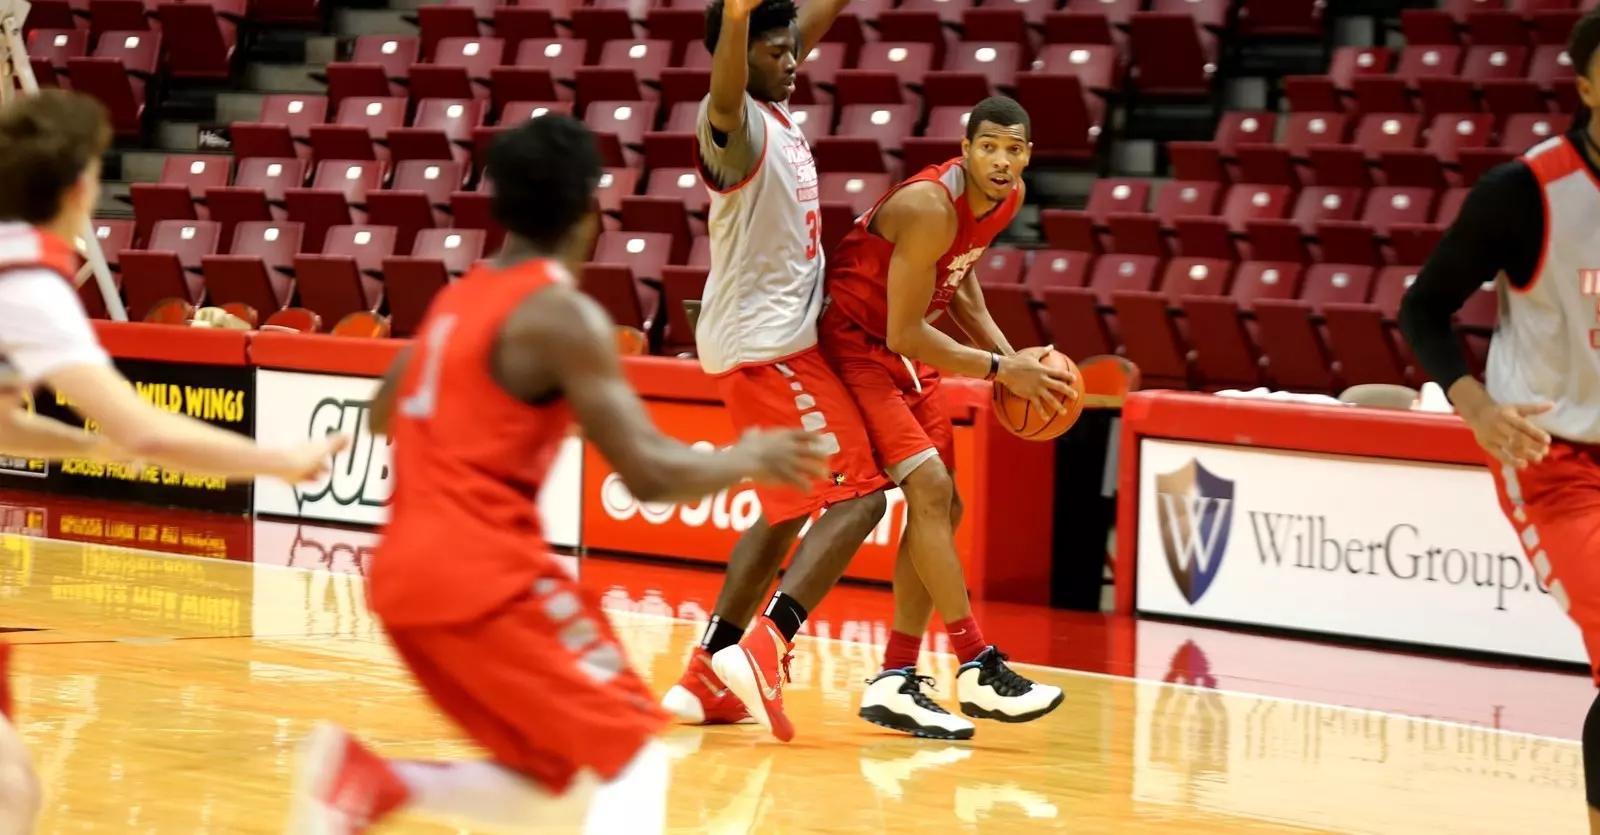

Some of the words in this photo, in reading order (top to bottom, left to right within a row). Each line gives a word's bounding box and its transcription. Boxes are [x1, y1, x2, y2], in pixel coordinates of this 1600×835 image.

[805, 210, 821, 260] 3
[136, 381, 182, 414] WILD
[185, 385, 244, 422] WINGS
[291, 397, 397, 516] SUB
[1157, 492, 1233, 573] W
